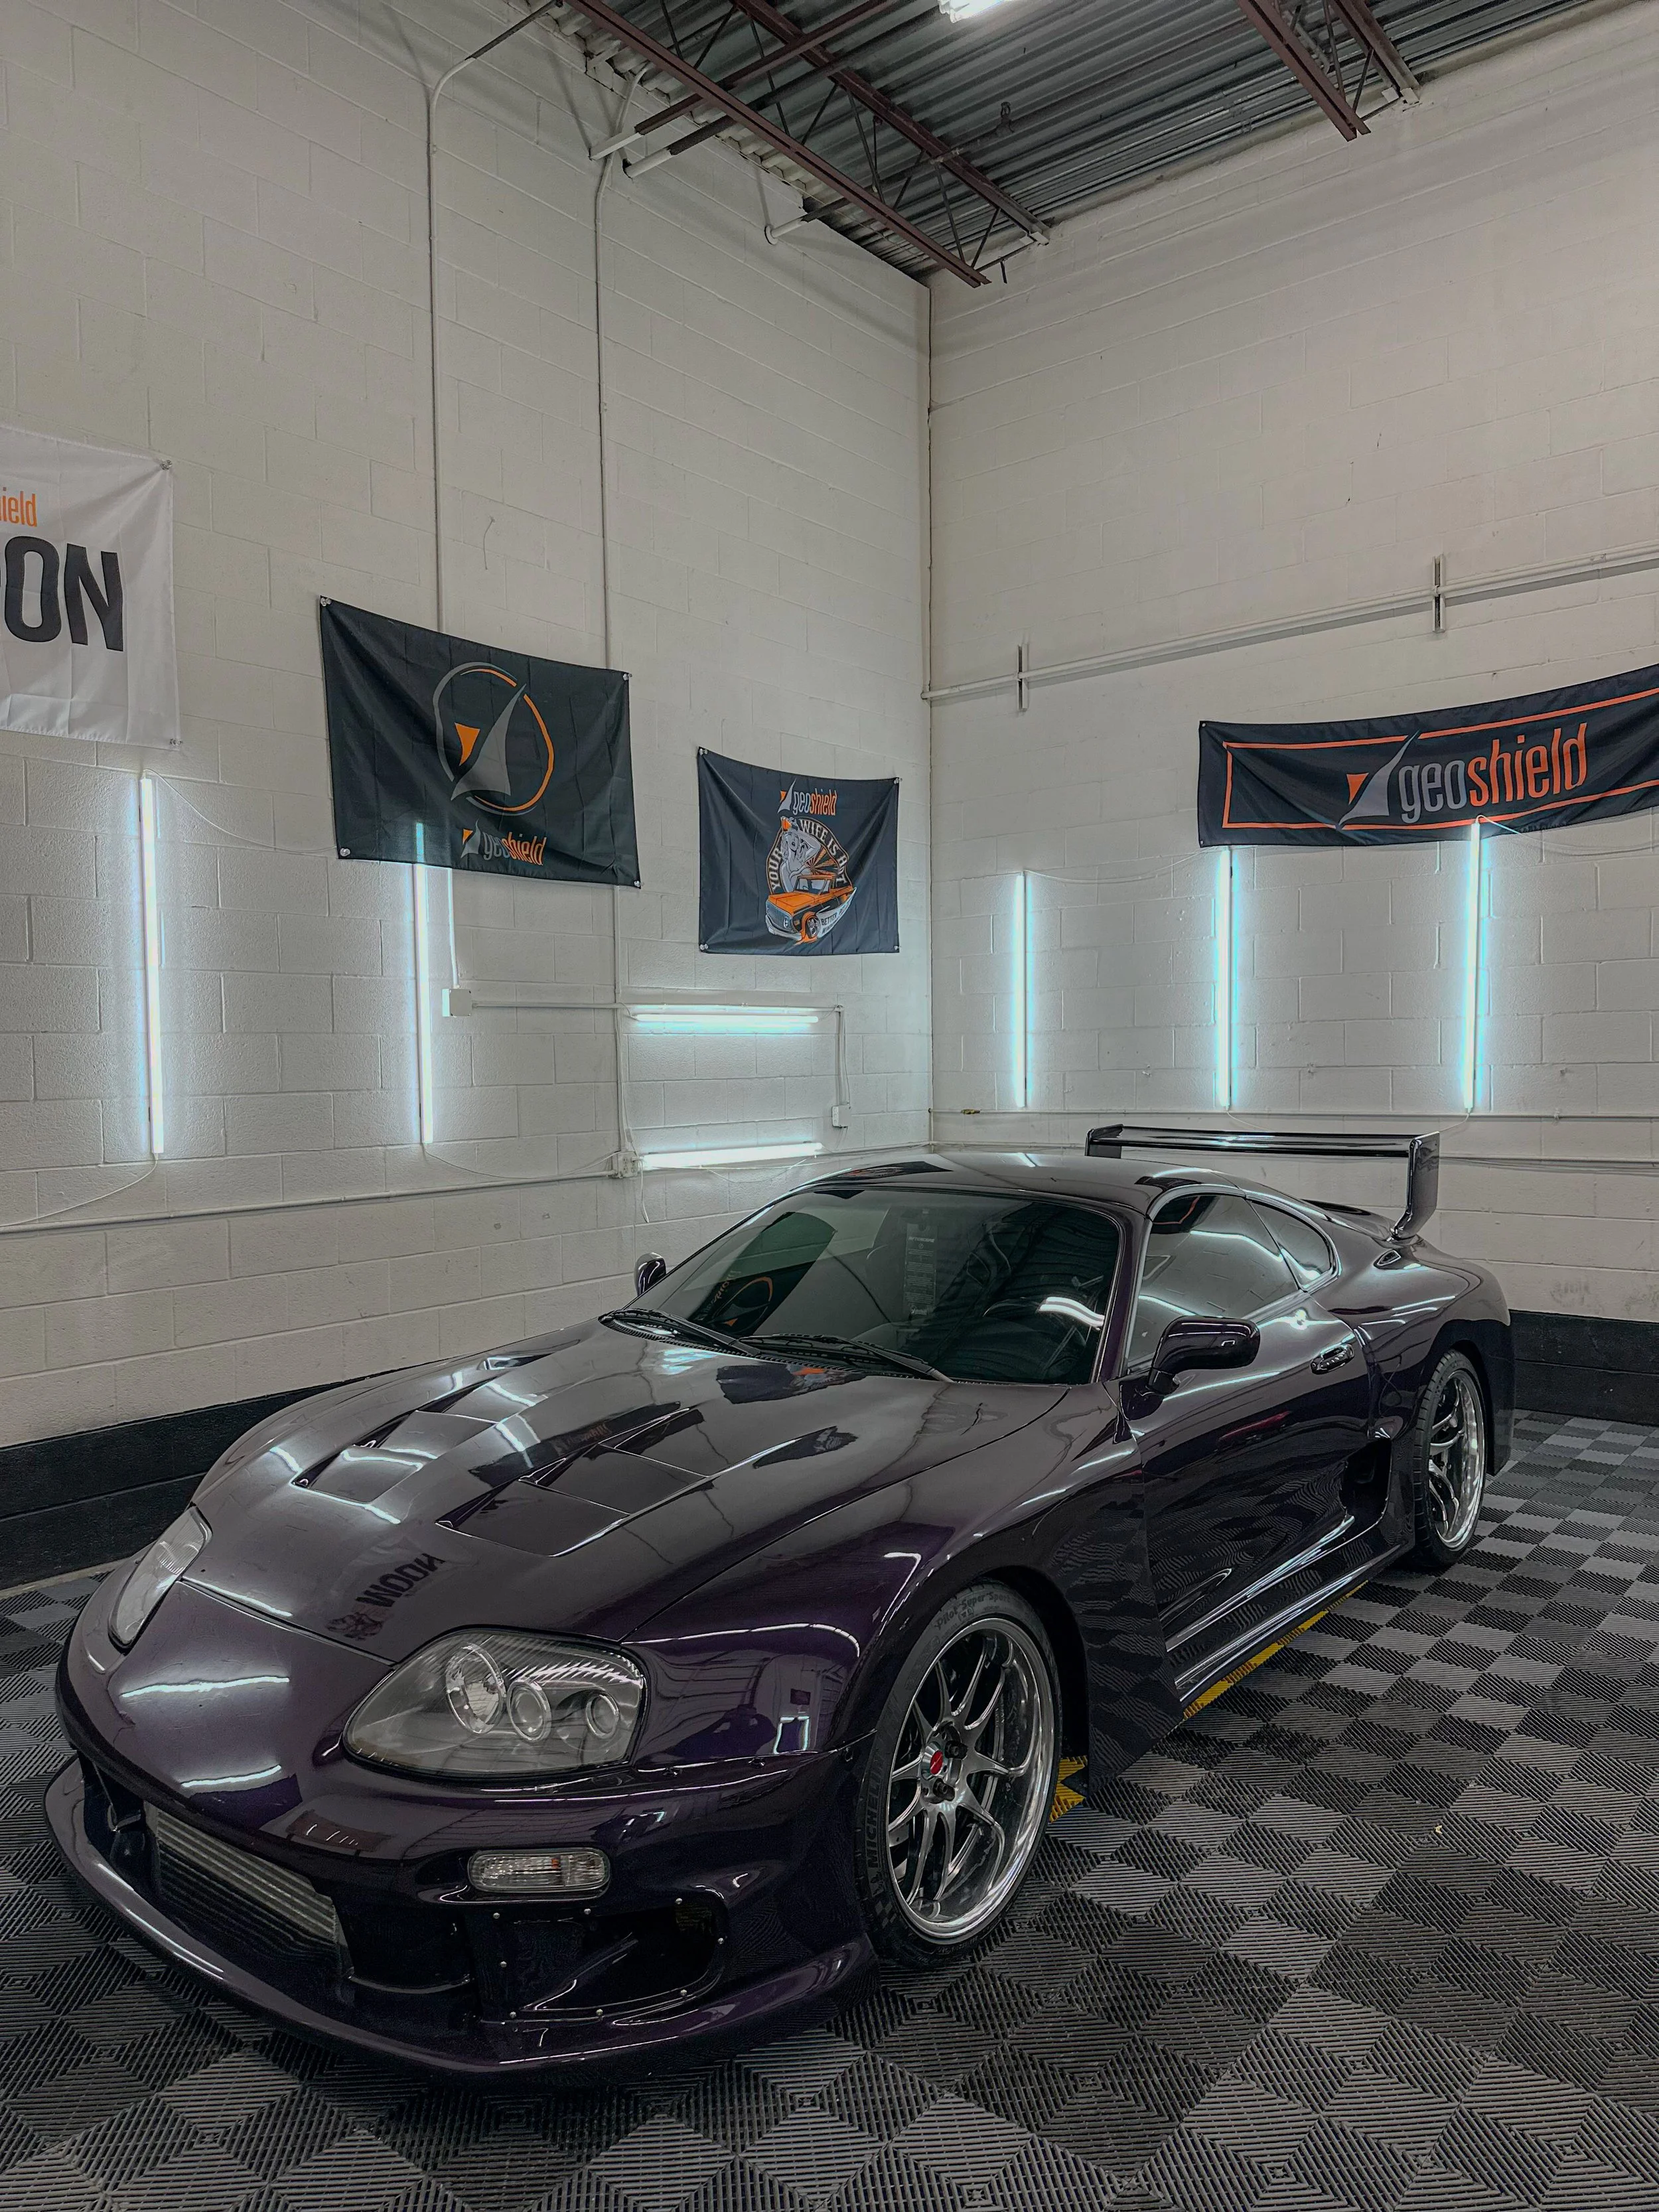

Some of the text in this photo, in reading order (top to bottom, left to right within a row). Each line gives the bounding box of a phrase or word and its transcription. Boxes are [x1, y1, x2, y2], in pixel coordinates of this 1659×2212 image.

[0, 487, 38, 528] ield
[0, 536, 124, 652] ON
[1400, 722, 1587, 824] geoshield
[792, 788, 837, 816] geoshield
[483, 831, 547, 866] geoshield
[768, 848, 783, 890] YOUR
[800, 820, 828, 842] WIFE
[827, 838, 839, 855] IS
[934, 1606, 958, 1630] Pilot
[958, 1594, 985, 1610] Super
[986, 1591, 1011, 1603] Sport
